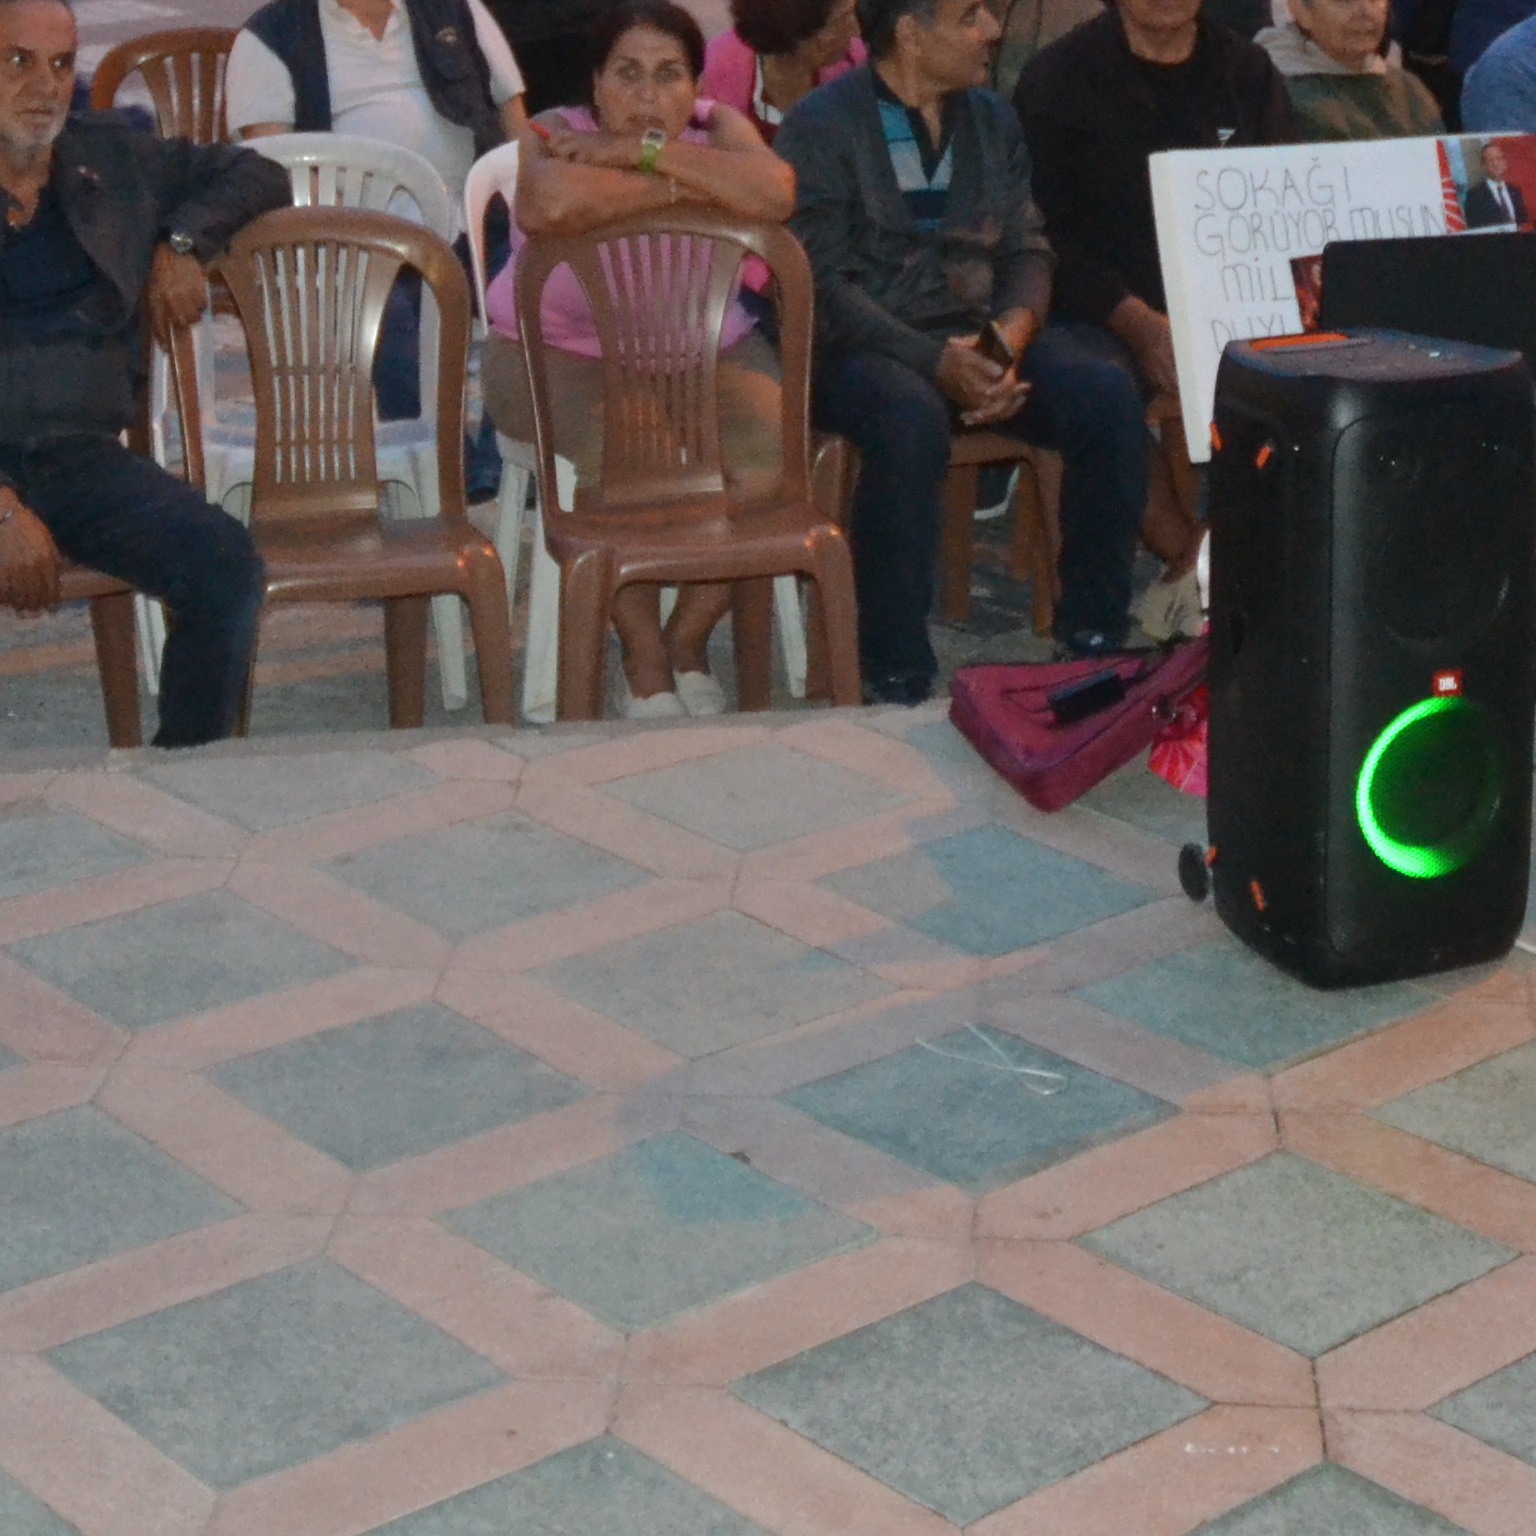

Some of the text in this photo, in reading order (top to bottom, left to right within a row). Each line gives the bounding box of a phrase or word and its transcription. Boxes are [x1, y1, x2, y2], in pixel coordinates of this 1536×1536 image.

[1194, 157, 1352, 211] SOKAĞI
[1221, 256, 1298, 302] MİL
[1438, 676, 1458, 691] JBL
